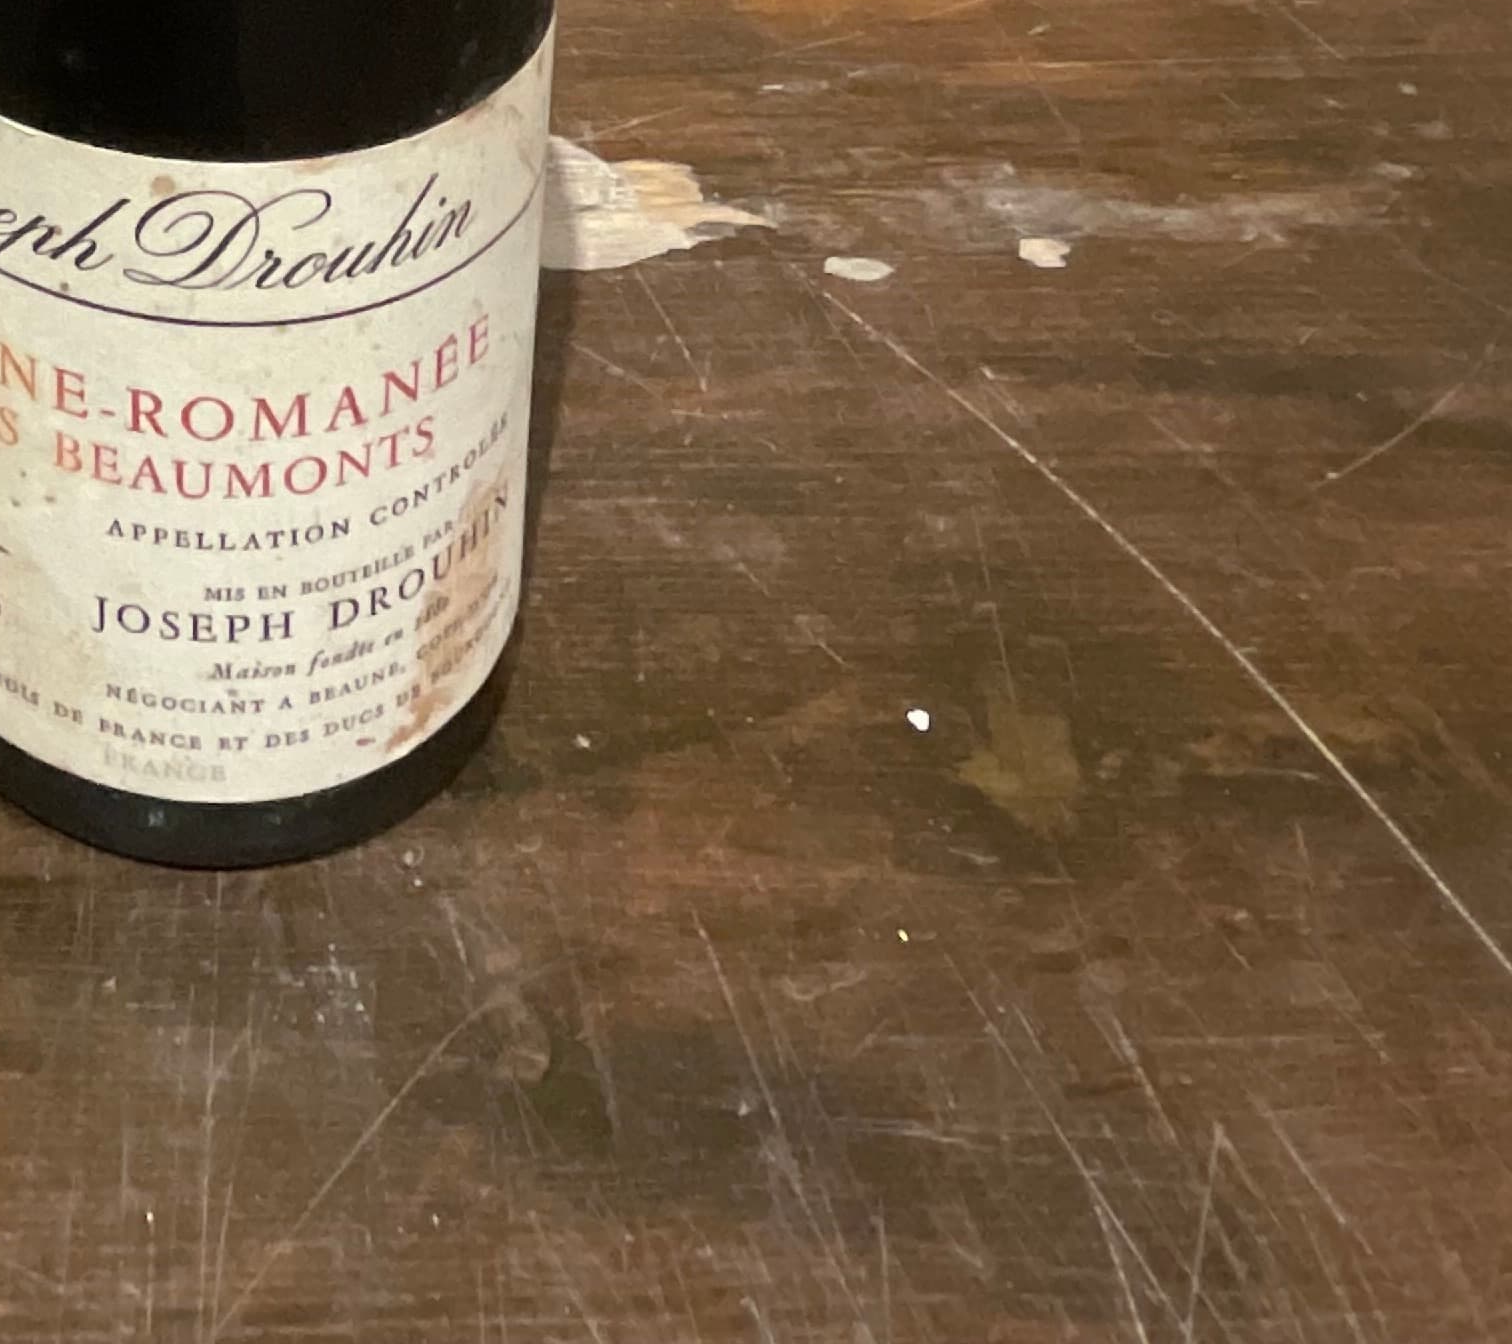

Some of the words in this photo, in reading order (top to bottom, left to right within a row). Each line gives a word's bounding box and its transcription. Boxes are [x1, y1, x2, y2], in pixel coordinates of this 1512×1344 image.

[123, 172, 473, 291] Drouhin
[54, 415, 437, 501] BEAUMONTS
[91, 595, 296, 644] JOSEPH
[328, 479, 509, 631] DROUHIN
[106, 517, 351, 552] APPELLATION
[204, 587, 246, 602] MIS
[257, 585, 288, 600] EN
[300, 544, 415, 596] BOUTEILLE
[207, 661, 296, 680] Maison
[53, 700, 84, 725] DE
[99, 718, 203, 750] FRANCE
[219, 735, 248, 751] ET
[265, 728, 310, 749] DES
[323, 703, 385, 738] DUCS
[105, 683, 265, 714] NÉGOCIANT
[277, 696, 293, 710] A
